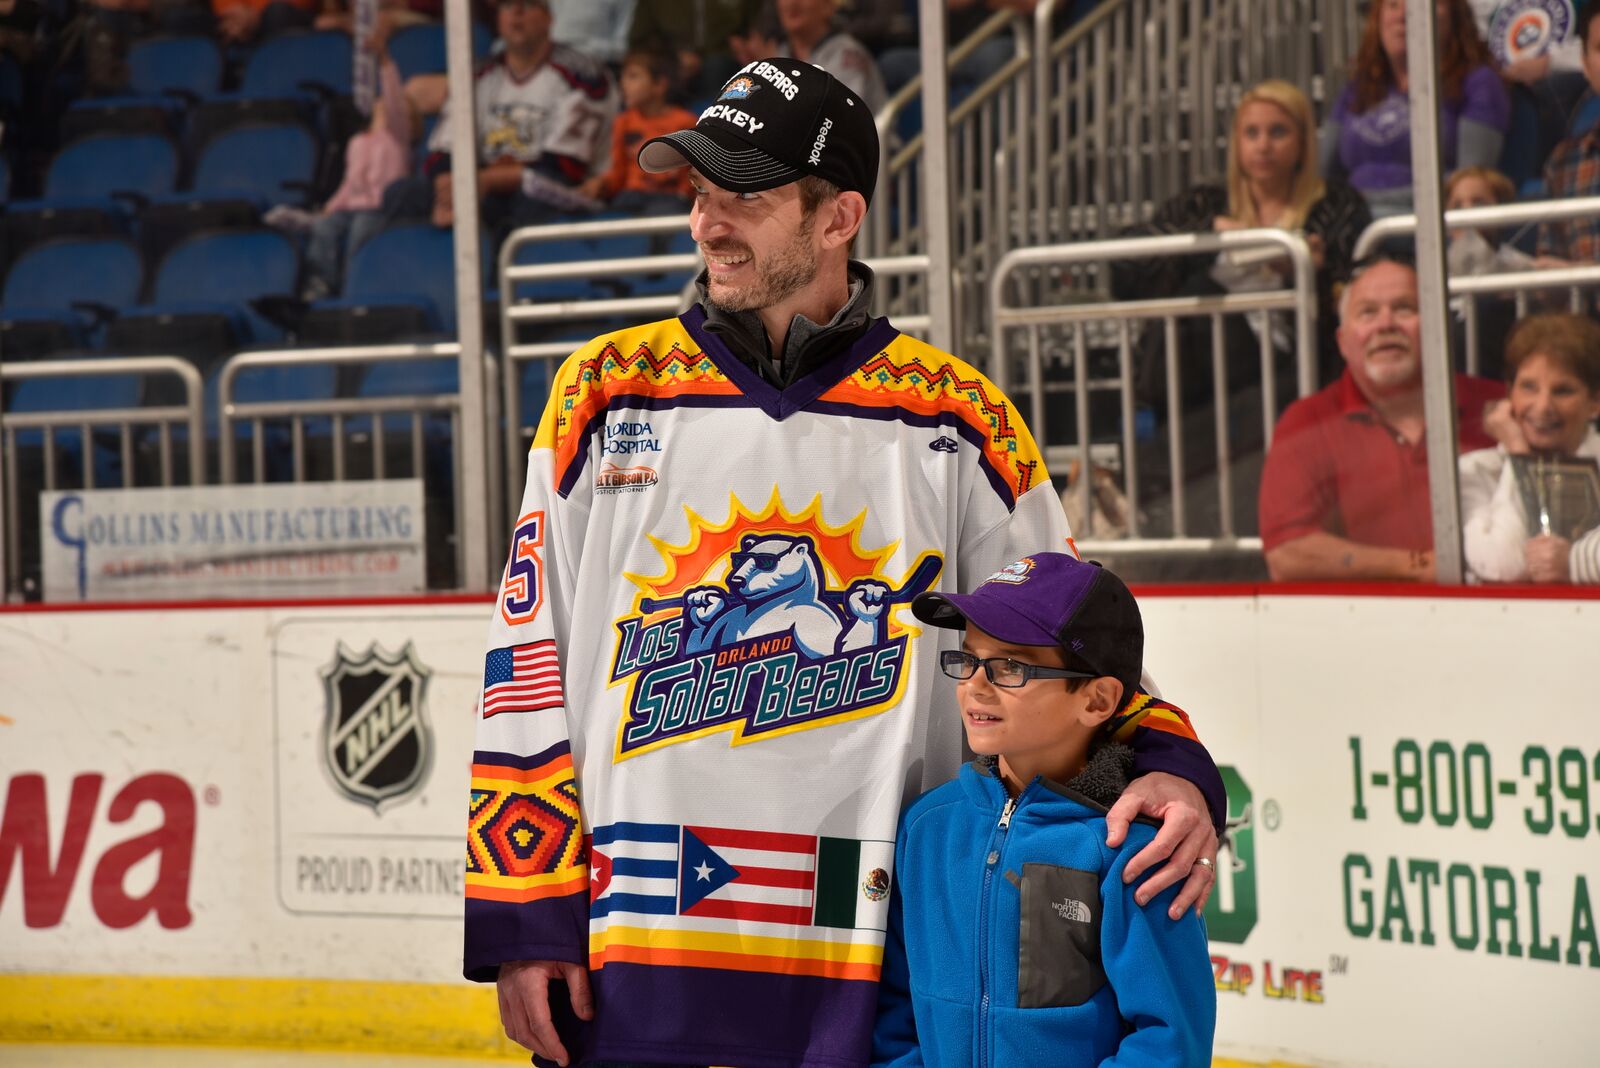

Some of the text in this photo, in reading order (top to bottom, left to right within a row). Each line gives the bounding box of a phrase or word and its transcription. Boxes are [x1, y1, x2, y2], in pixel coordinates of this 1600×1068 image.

[753, 62, 799, 101] BEARS
[807, 117, 833, 167] Reebok
[606, 422, 652, 439] LORIDA
[612, 472, 642, 487] GIBSON
[189, 504, 413, 546] MANUFACTURING
[501, 510, 544, 626] 5
[717, 636, 792, 666] ORLANDO
[345, 688, 410, 774] NHL
[297, 856, 373, 894] PROUD
[1052, 902, 1078, 914] NORTH
[1058, 910, 1078, 921] FACE
[1064, 898, 1079, 908] THE
